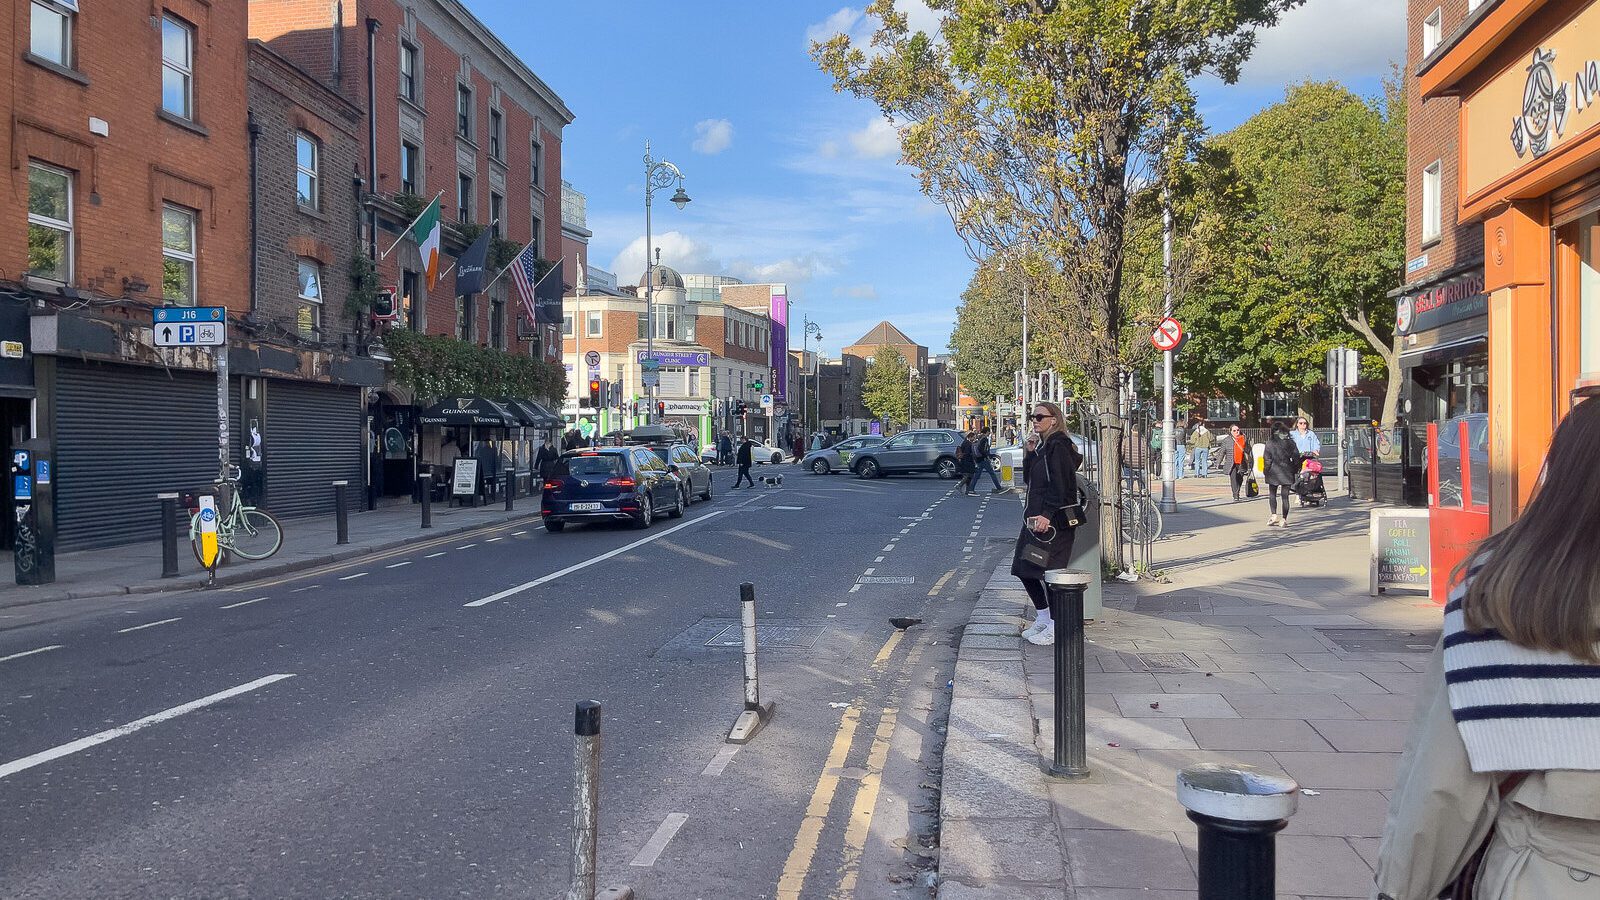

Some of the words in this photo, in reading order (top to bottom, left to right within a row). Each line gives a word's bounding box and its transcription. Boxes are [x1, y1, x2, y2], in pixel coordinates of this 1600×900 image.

[181, 310, 197, 320] J16
[669, 403, 701, 412] pharmacy
[1394, 519, 1408, 528] TEA
[1388, 528, 1417, 537] COFFEE
[1383, 557, 1420, 566] SANDWICH
[1378, 573, 1419, 582] BREAKFAST
